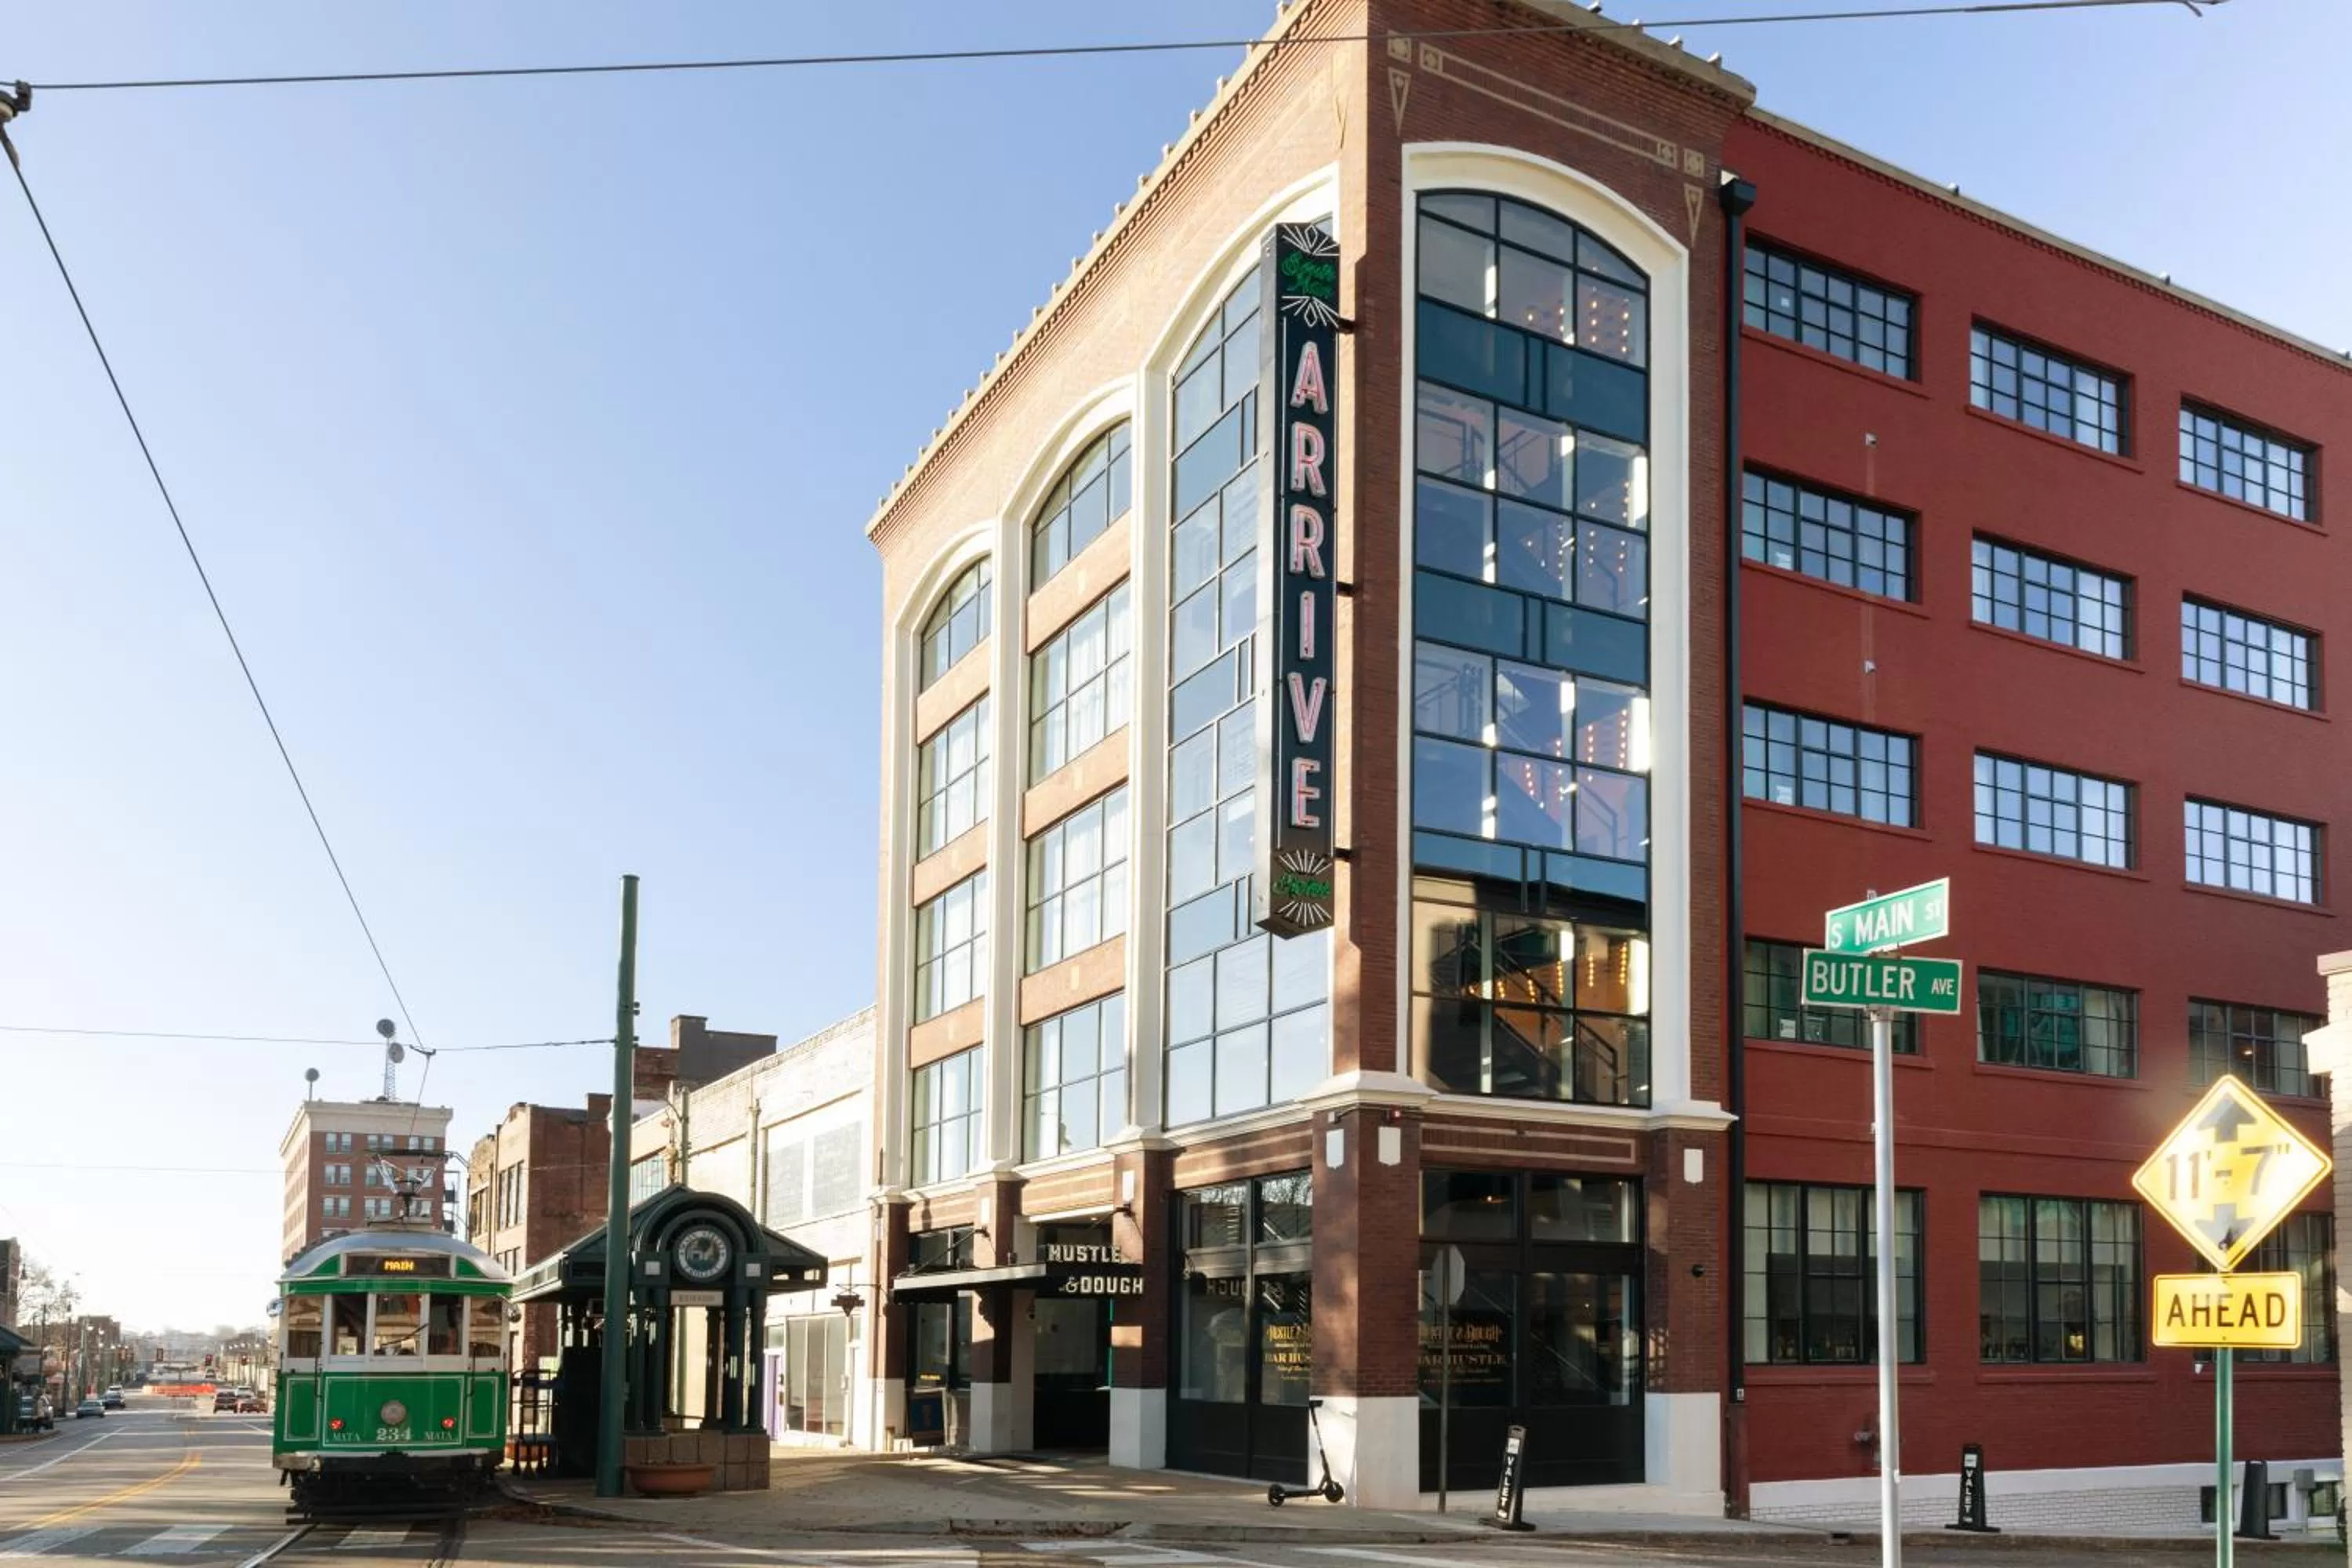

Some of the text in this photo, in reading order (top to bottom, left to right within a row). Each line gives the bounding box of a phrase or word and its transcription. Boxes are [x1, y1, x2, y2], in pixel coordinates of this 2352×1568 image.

[1287, 341, 1329, 828] ARRIVE
[1831, 899, 1943, 949] S MAIN ST
[1811, 960, 1955, 1000] BUTLER AVE
[384, 1261, 415, 1271] MAIN
[1047, 1243, 1122, 1264] HUSTLE
[2166, 1293, 2286, 1328] AHEAD
[376, 1427, 412, 1442] 234
[1501, 1456, 1515, 1508] VALET
[1964, 1469, 1973, 1514] VALET
